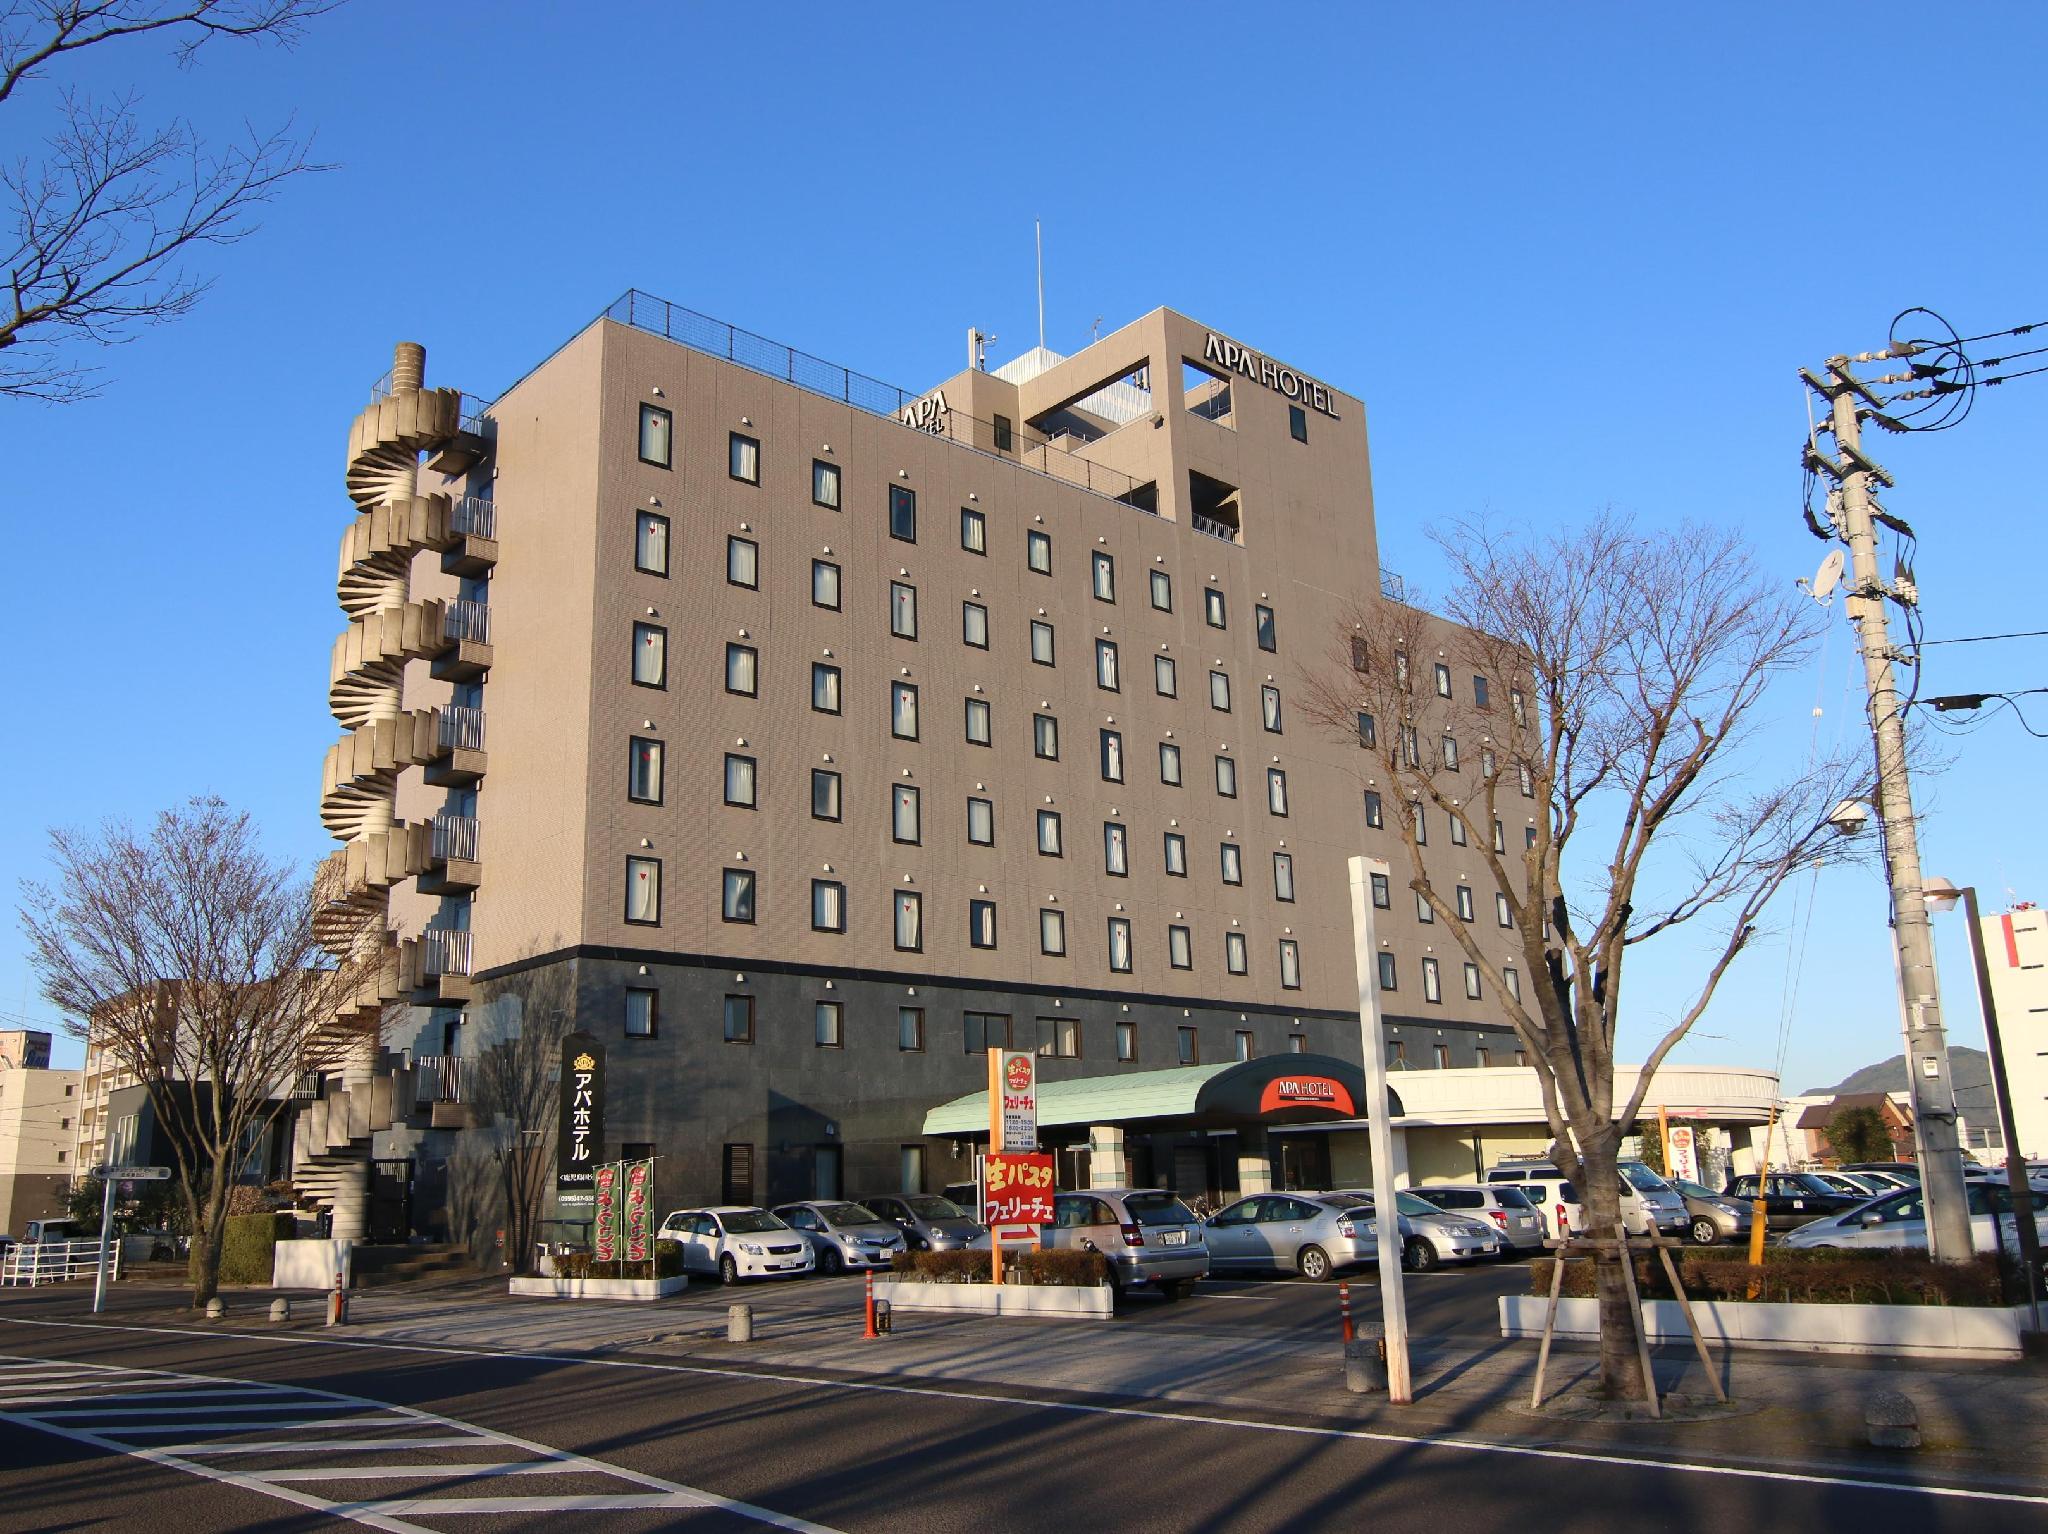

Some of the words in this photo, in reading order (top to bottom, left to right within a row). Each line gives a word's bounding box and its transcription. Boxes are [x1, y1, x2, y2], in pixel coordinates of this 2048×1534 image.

[1204, 333, 1257, 383] APA
[1261, 359, 1340, 420] HOTEL
[903, 390, 948, 428] APA
[921, 418, 944, 435] TEL
[1004, 1096, 1034, 1110] フェリーチェ
[1279, 1081, 1300, 1094] APA
[1301, 1082, 1334, 1096] HOTEL
[571, 1073, 593, 1161] アパホテル
[986, 1158, 1053, 1192] 生パスタ
[986, 1197, 1054, 1222] フェリーチェ
